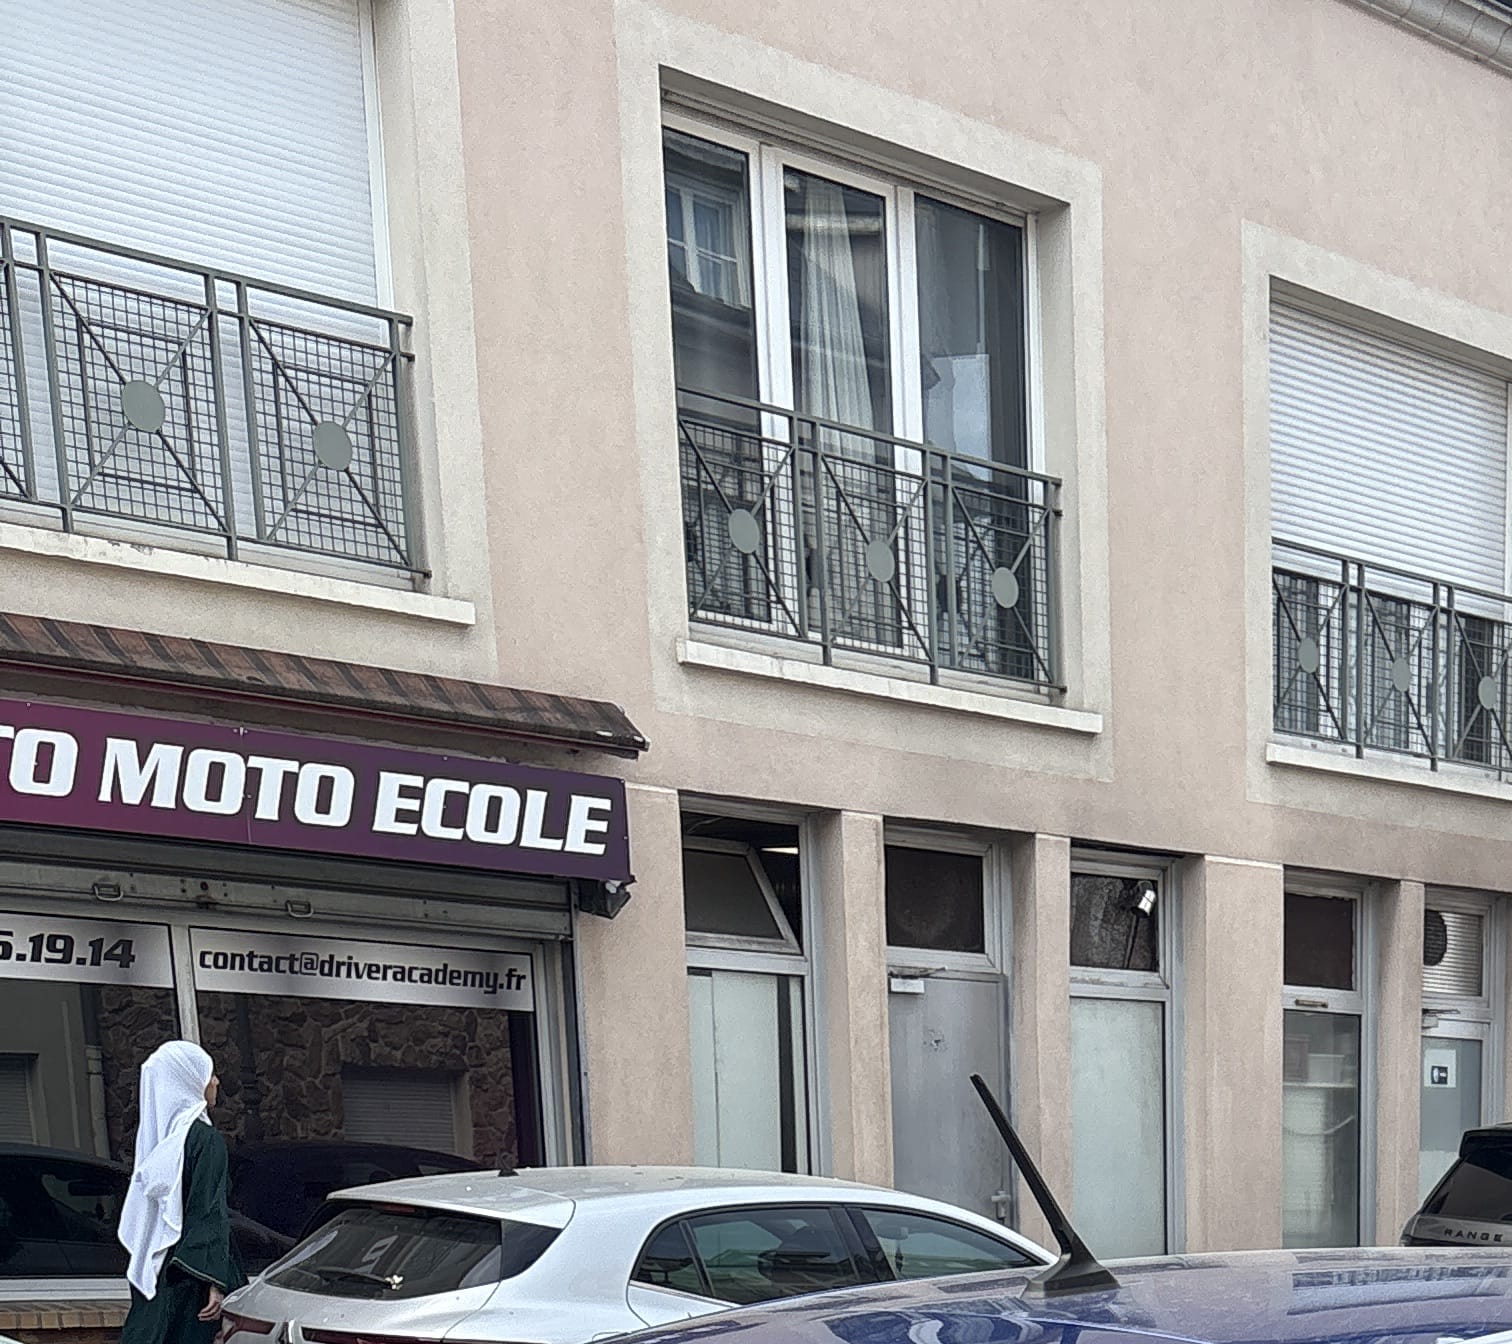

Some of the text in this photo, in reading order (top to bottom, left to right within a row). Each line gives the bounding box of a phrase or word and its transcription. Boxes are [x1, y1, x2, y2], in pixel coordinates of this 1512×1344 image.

[98, 737, 355, 828] MOTO
[371, 771, 612, 856] ECOLE
[199, 949, 527, 995] contact@driveracademy.fr
[1444, 1228, 1503, 1243] RANGE
